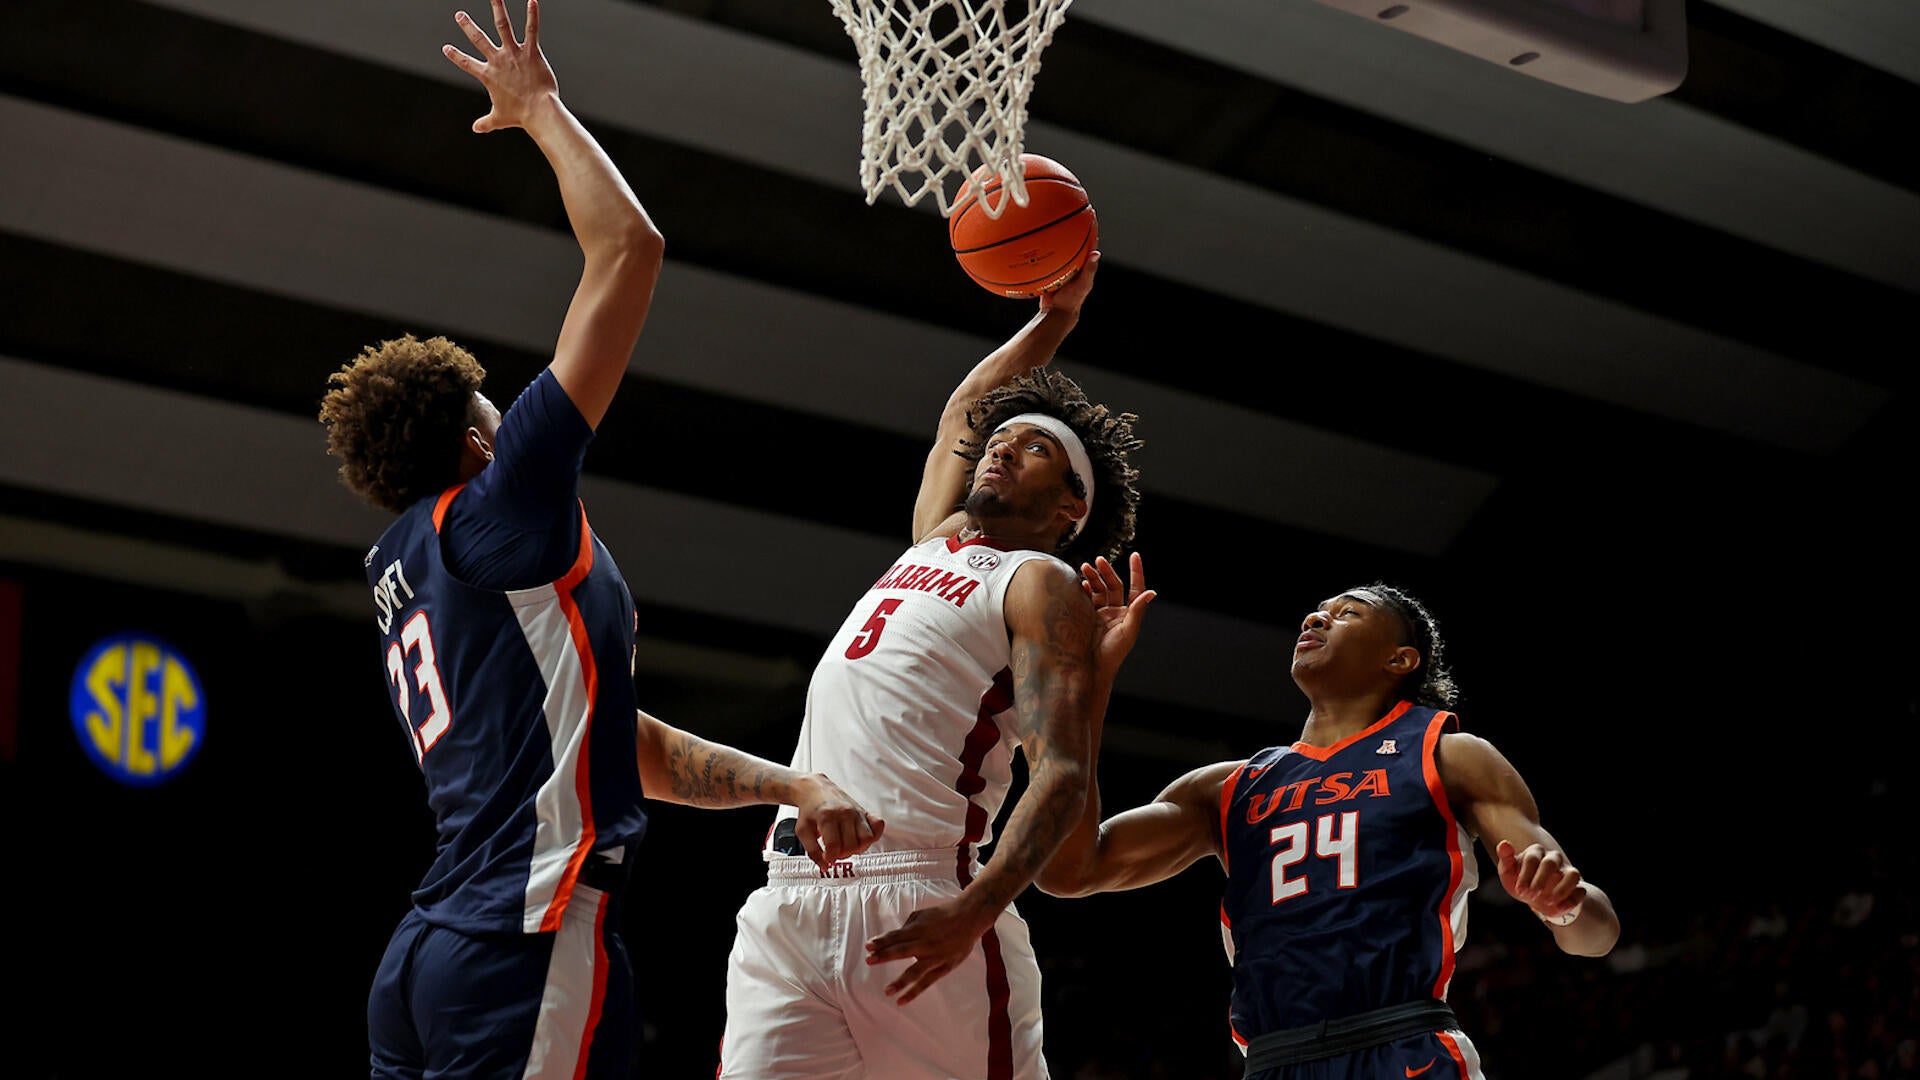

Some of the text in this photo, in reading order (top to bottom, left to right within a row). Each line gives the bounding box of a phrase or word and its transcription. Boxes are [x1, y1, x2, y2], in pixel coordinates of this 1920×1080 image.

[845, 599, 904, 660] 5
[84, 642, 197, 775] SEC
[387, 609, 452, 766] 23
[1247, 769, 1391, 824] UTSA
[1270, 810, 1359, 906] 24
